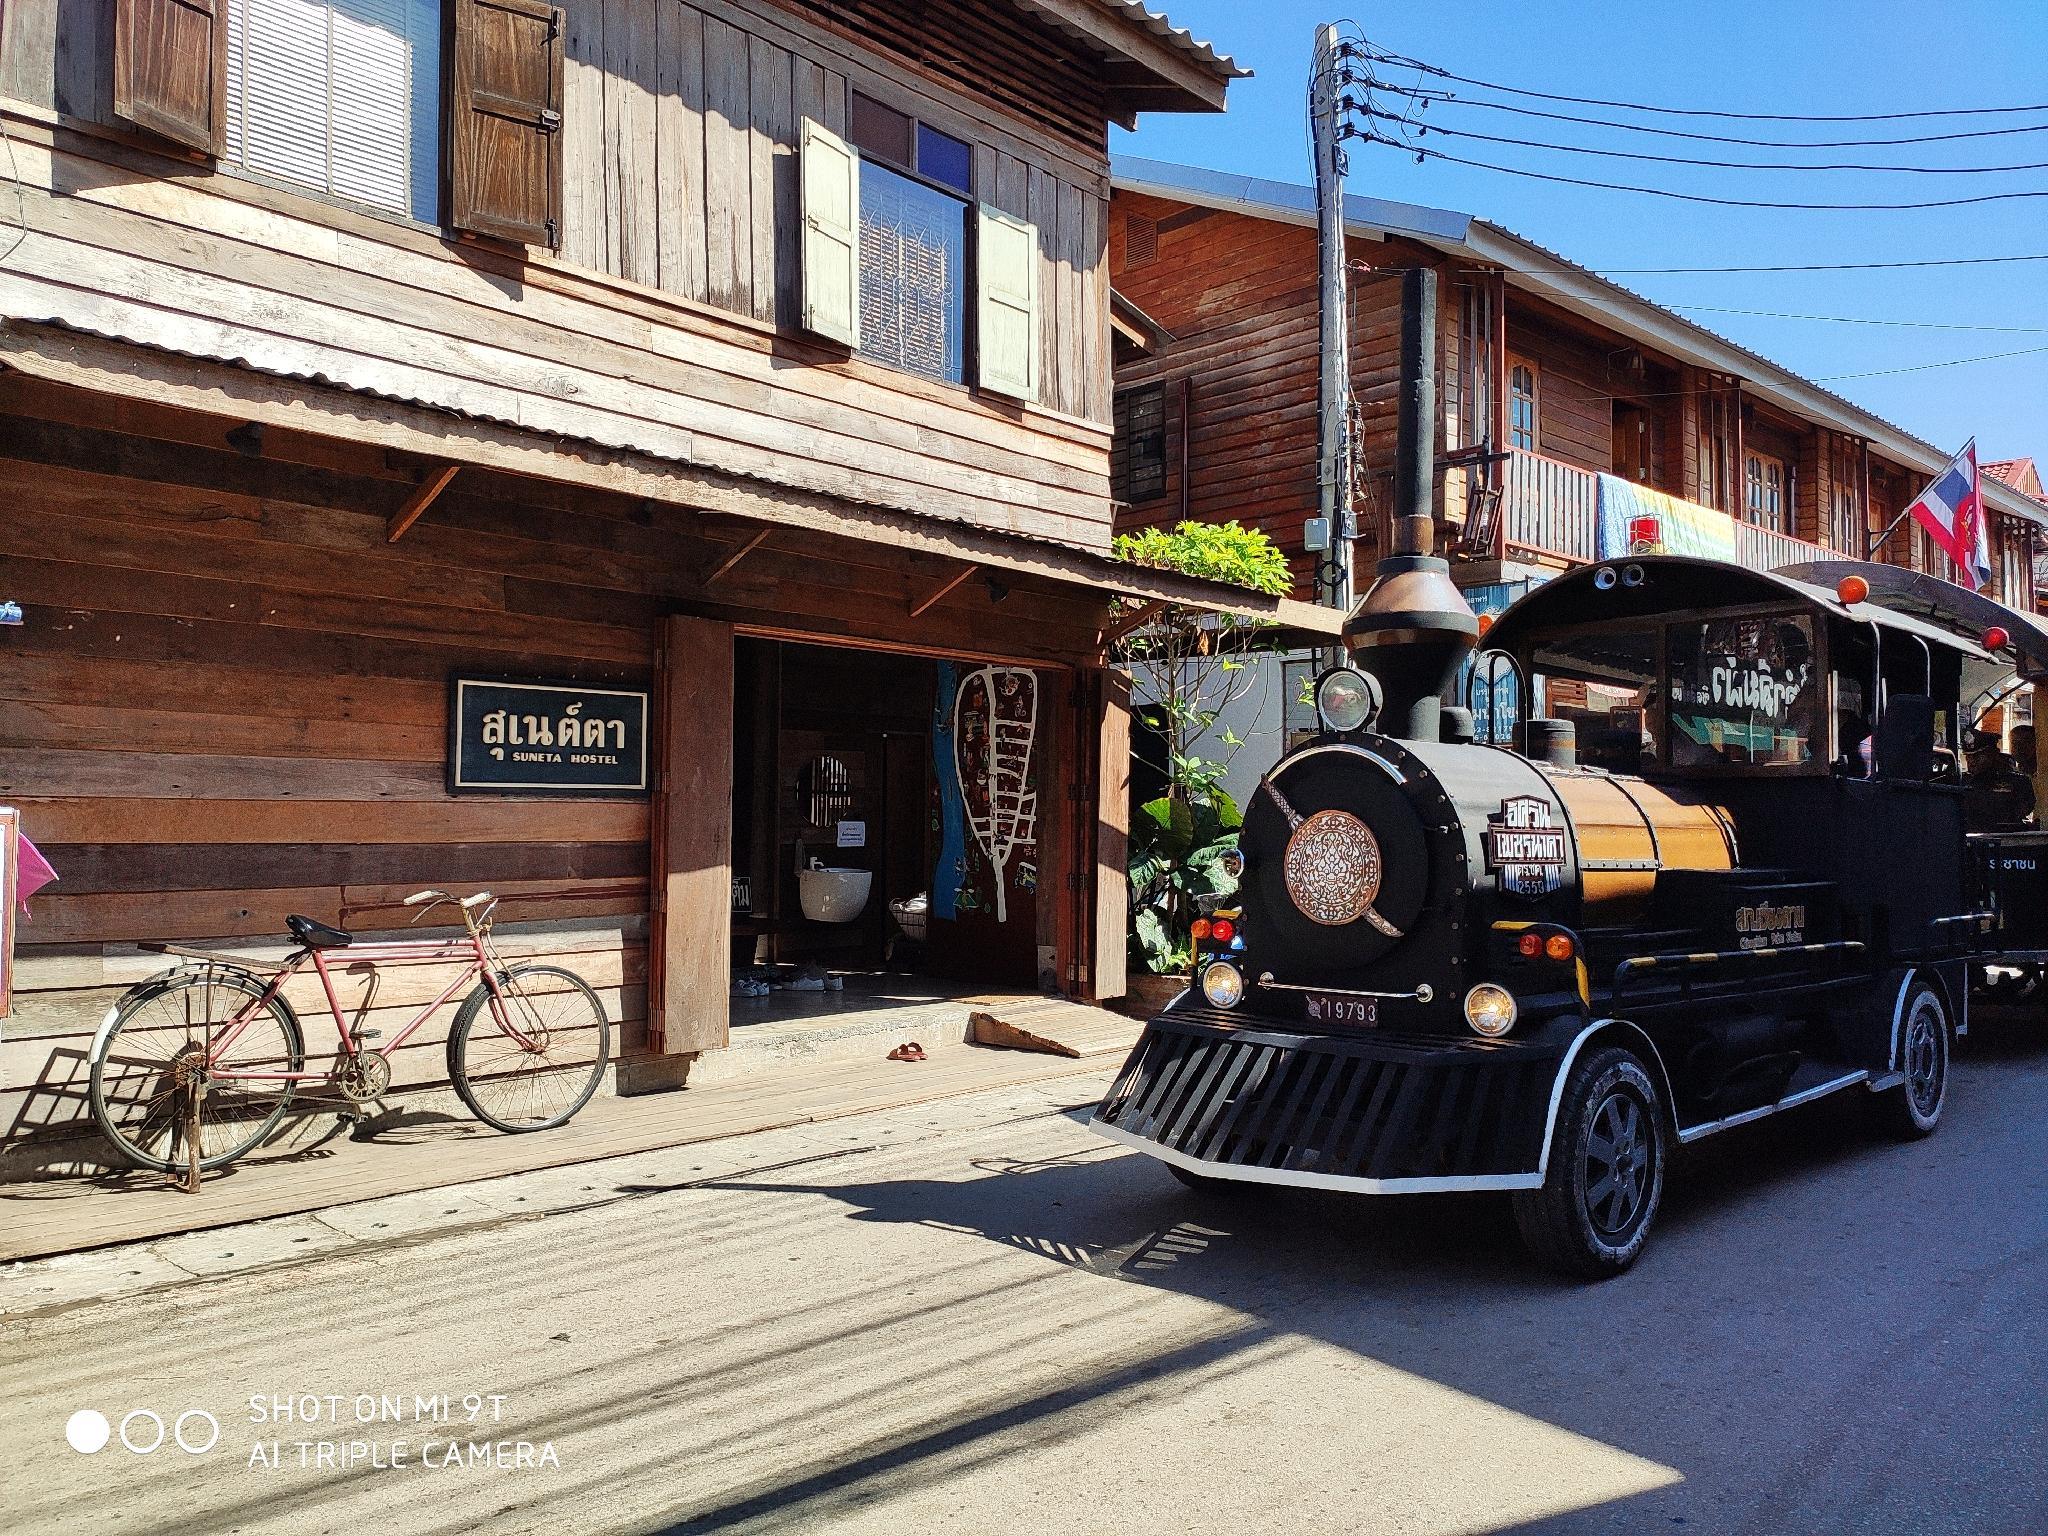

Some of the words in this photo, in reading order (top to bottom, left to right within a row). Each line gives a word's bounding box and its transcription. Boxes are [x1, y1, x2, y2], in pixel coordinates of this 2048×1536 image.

[512, 752, 562, 763] SUNETA
[570, 754, 618, 765] HOSTEL
[1327, 1001, 1376, 1021] 19793
